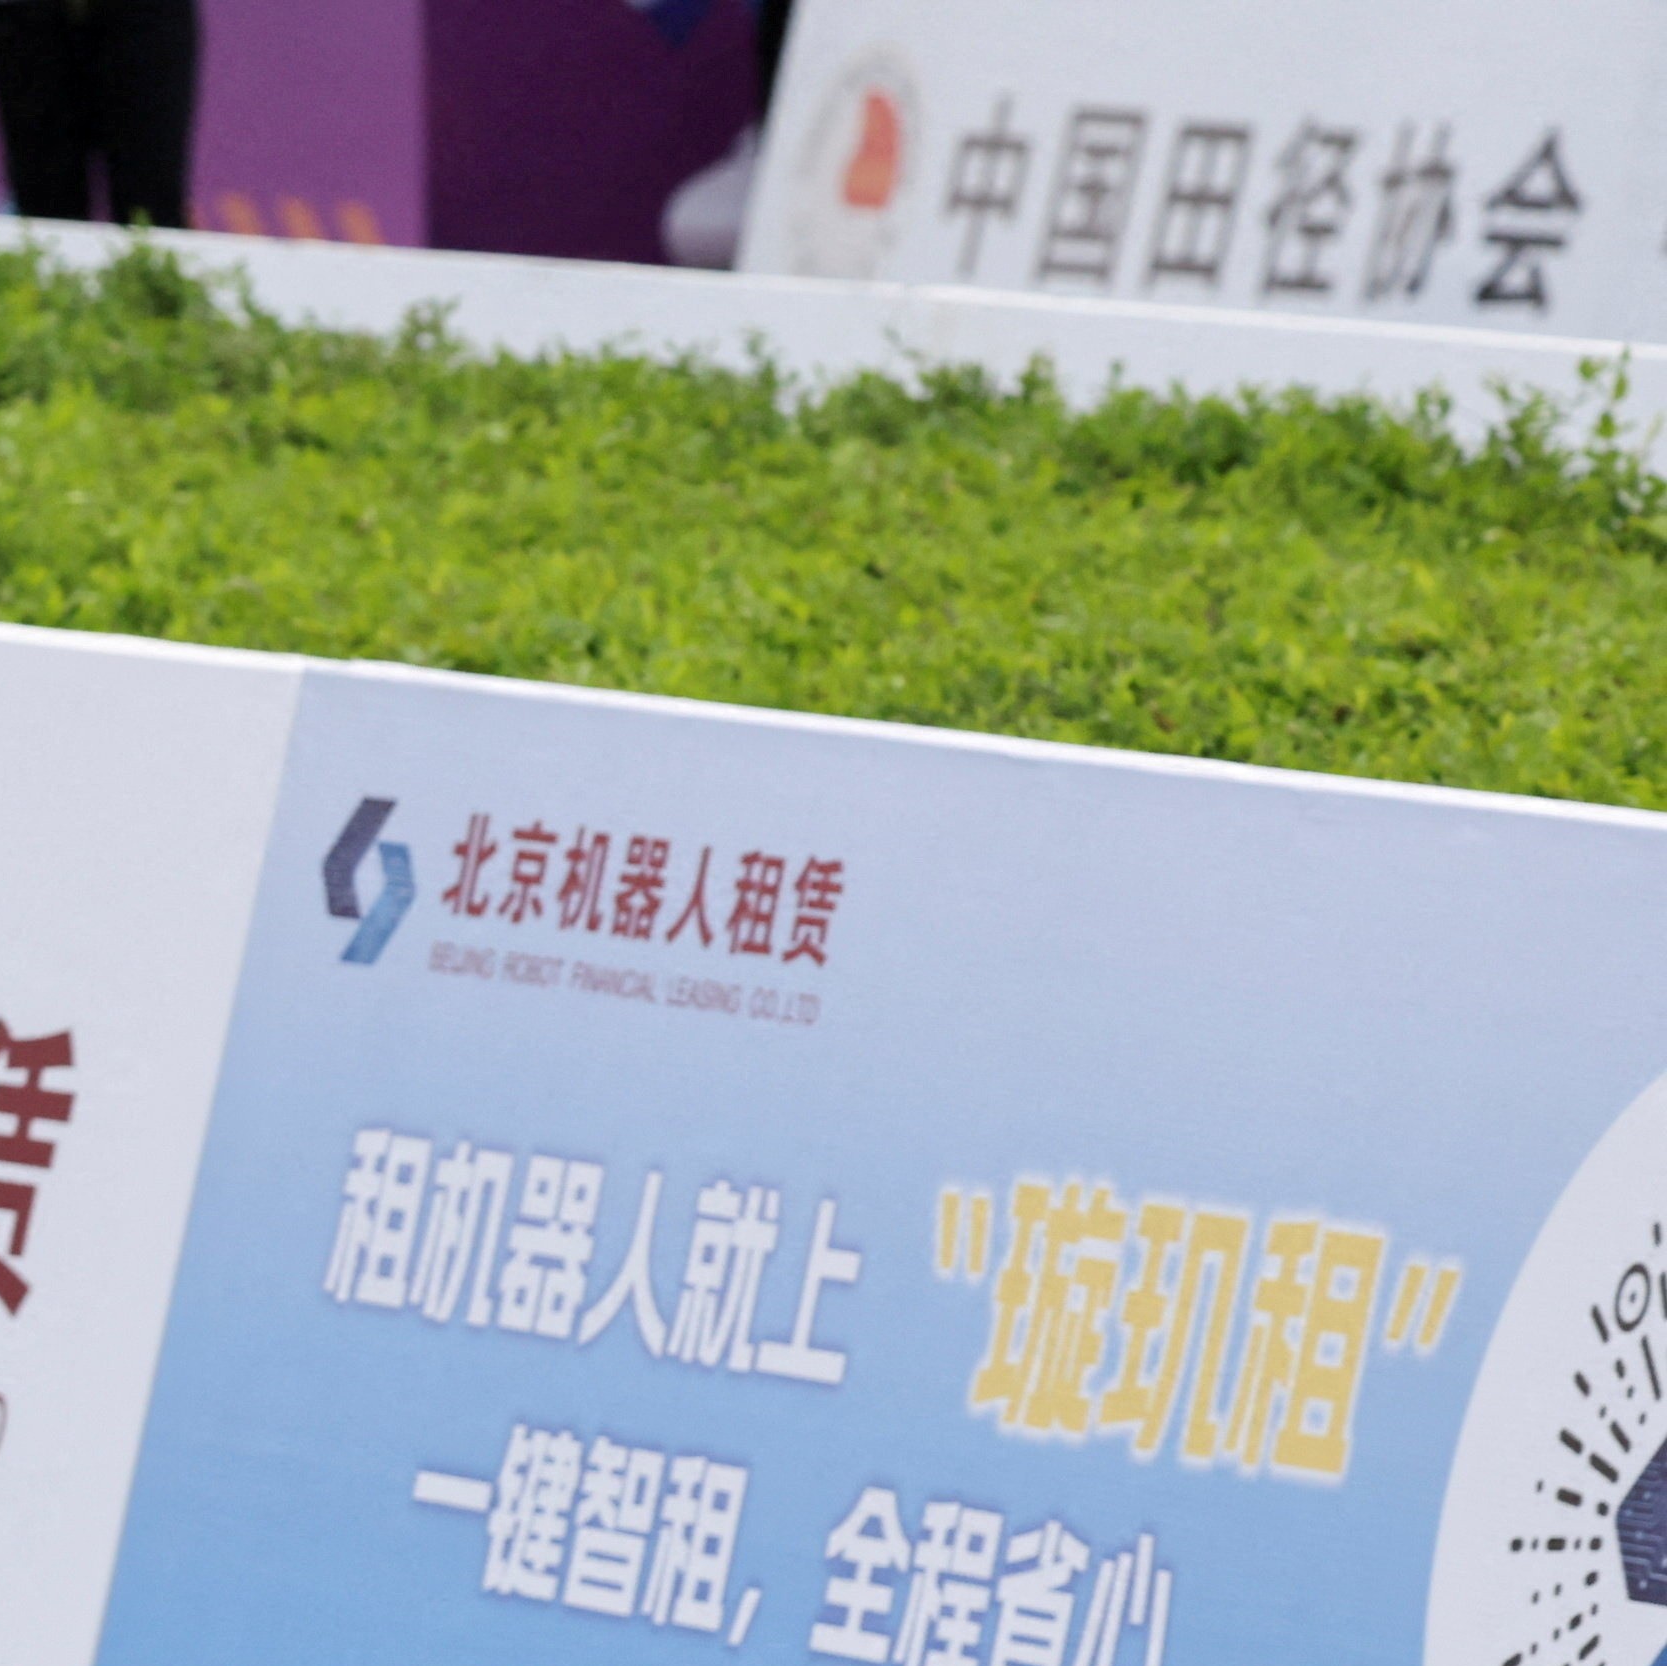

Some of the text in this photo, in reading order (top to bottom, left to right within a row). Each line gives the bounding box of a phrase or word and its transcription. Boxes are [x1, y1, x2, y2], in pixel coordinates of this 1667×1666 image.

[946, 92, 1581, 312] 中国田径协会
[442, 812, 845, 967] 北京机器人租赁
[323, 1126, 864, 1385] 租机器人就上
